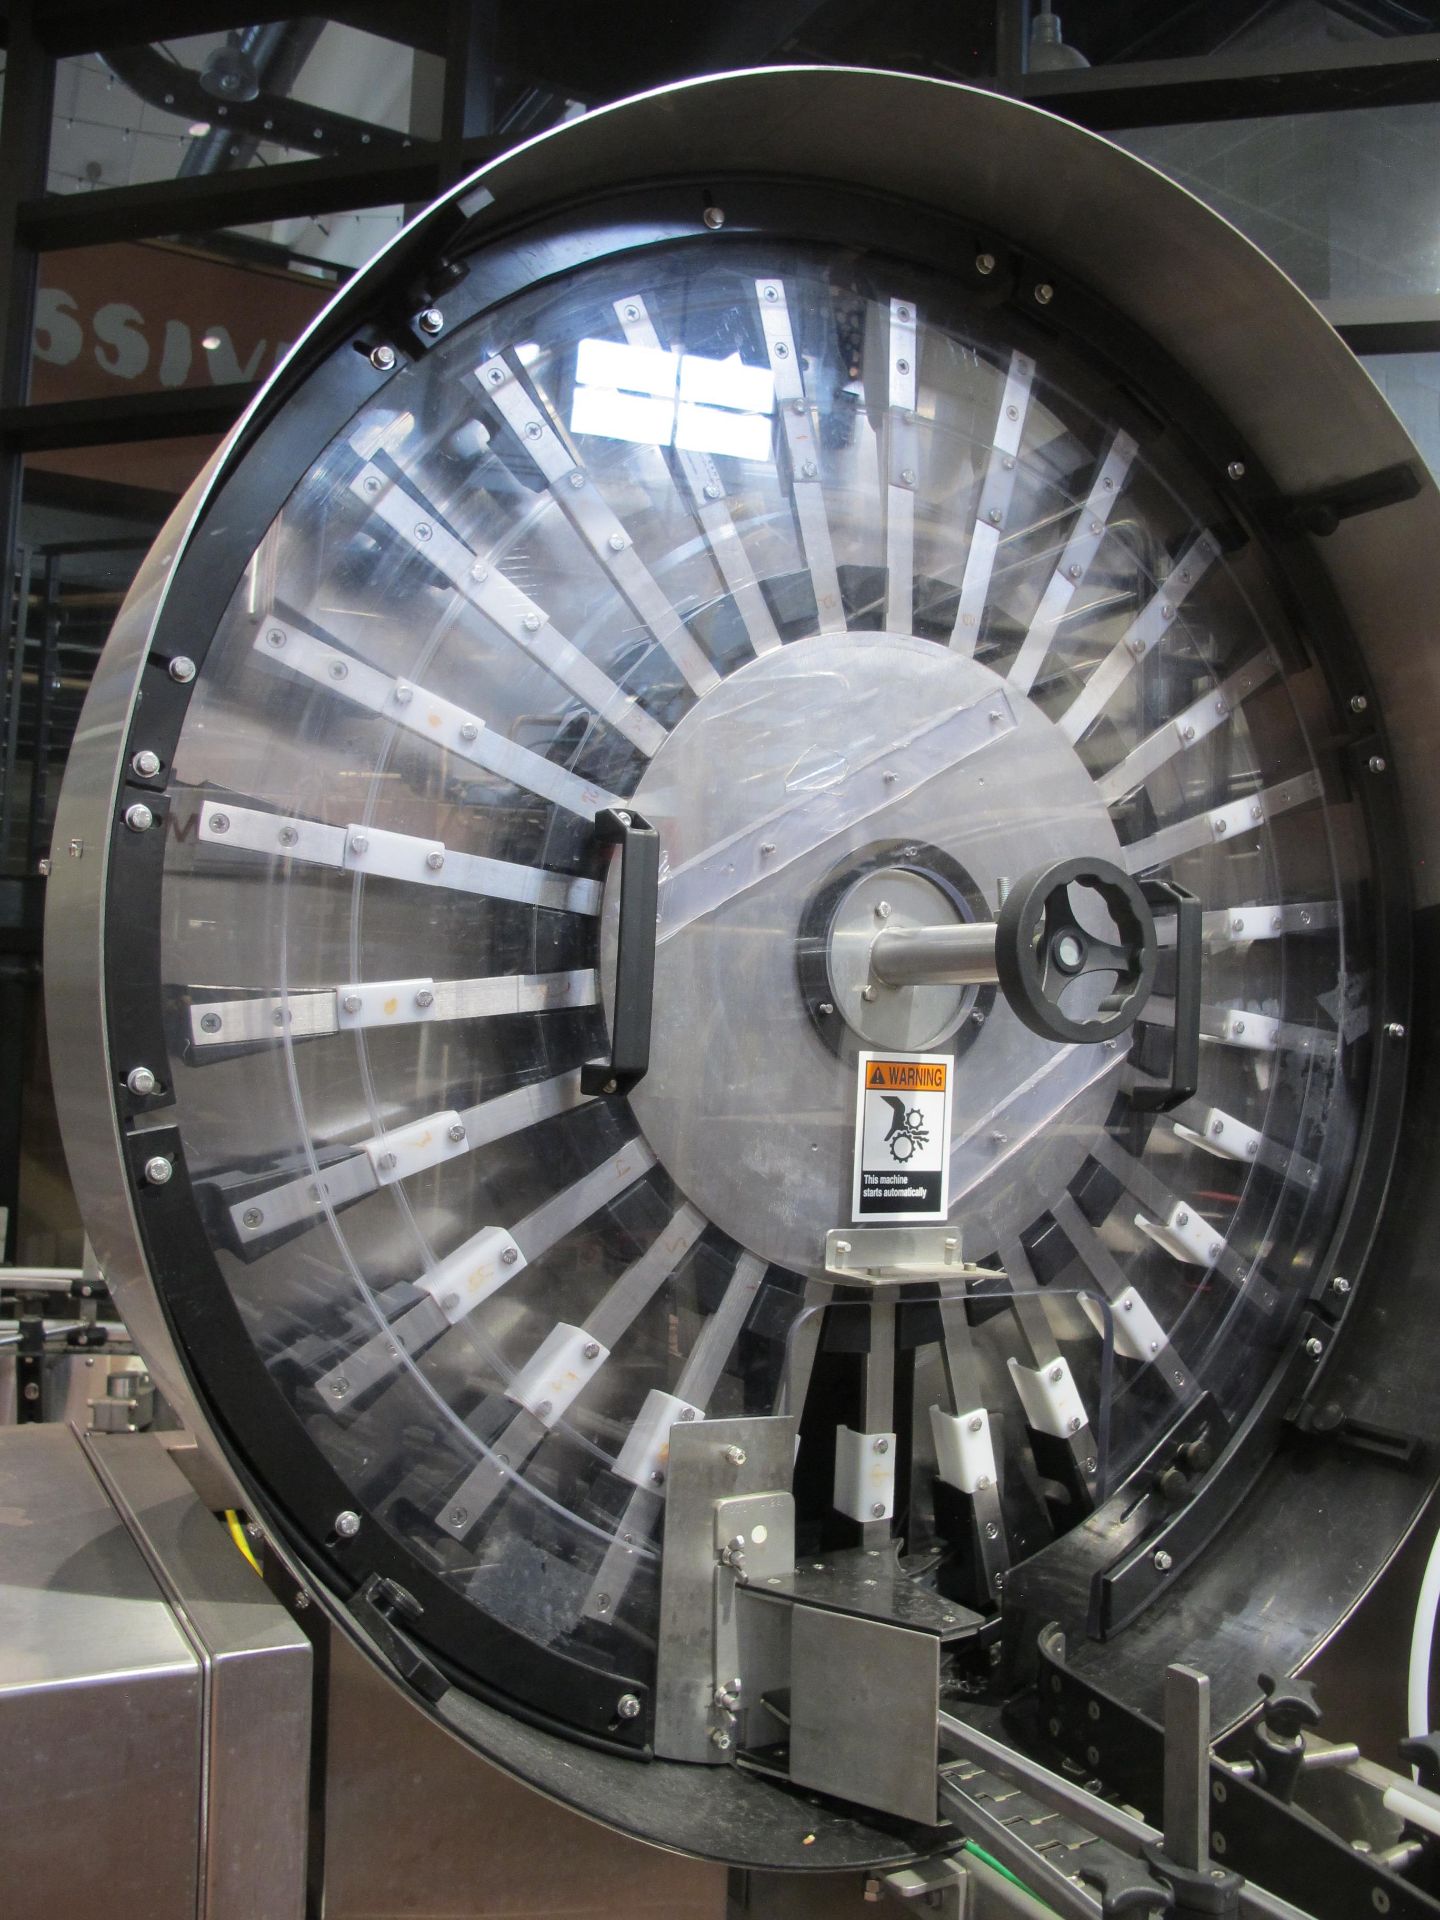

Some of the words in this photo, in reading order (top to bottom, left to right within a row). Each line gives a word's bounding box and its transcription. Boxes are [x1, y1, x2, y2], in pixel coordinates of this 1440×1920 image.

[33, 288, 293, 388] SSIV
[889, 1066, 943, 1087] WARNING
[864, 1174, 879, 1184] This
[880, 1174, 908, 1184] machine
[863, 1187, 882, 1197] starts
[883, 1186, 927, 1199] automatically
